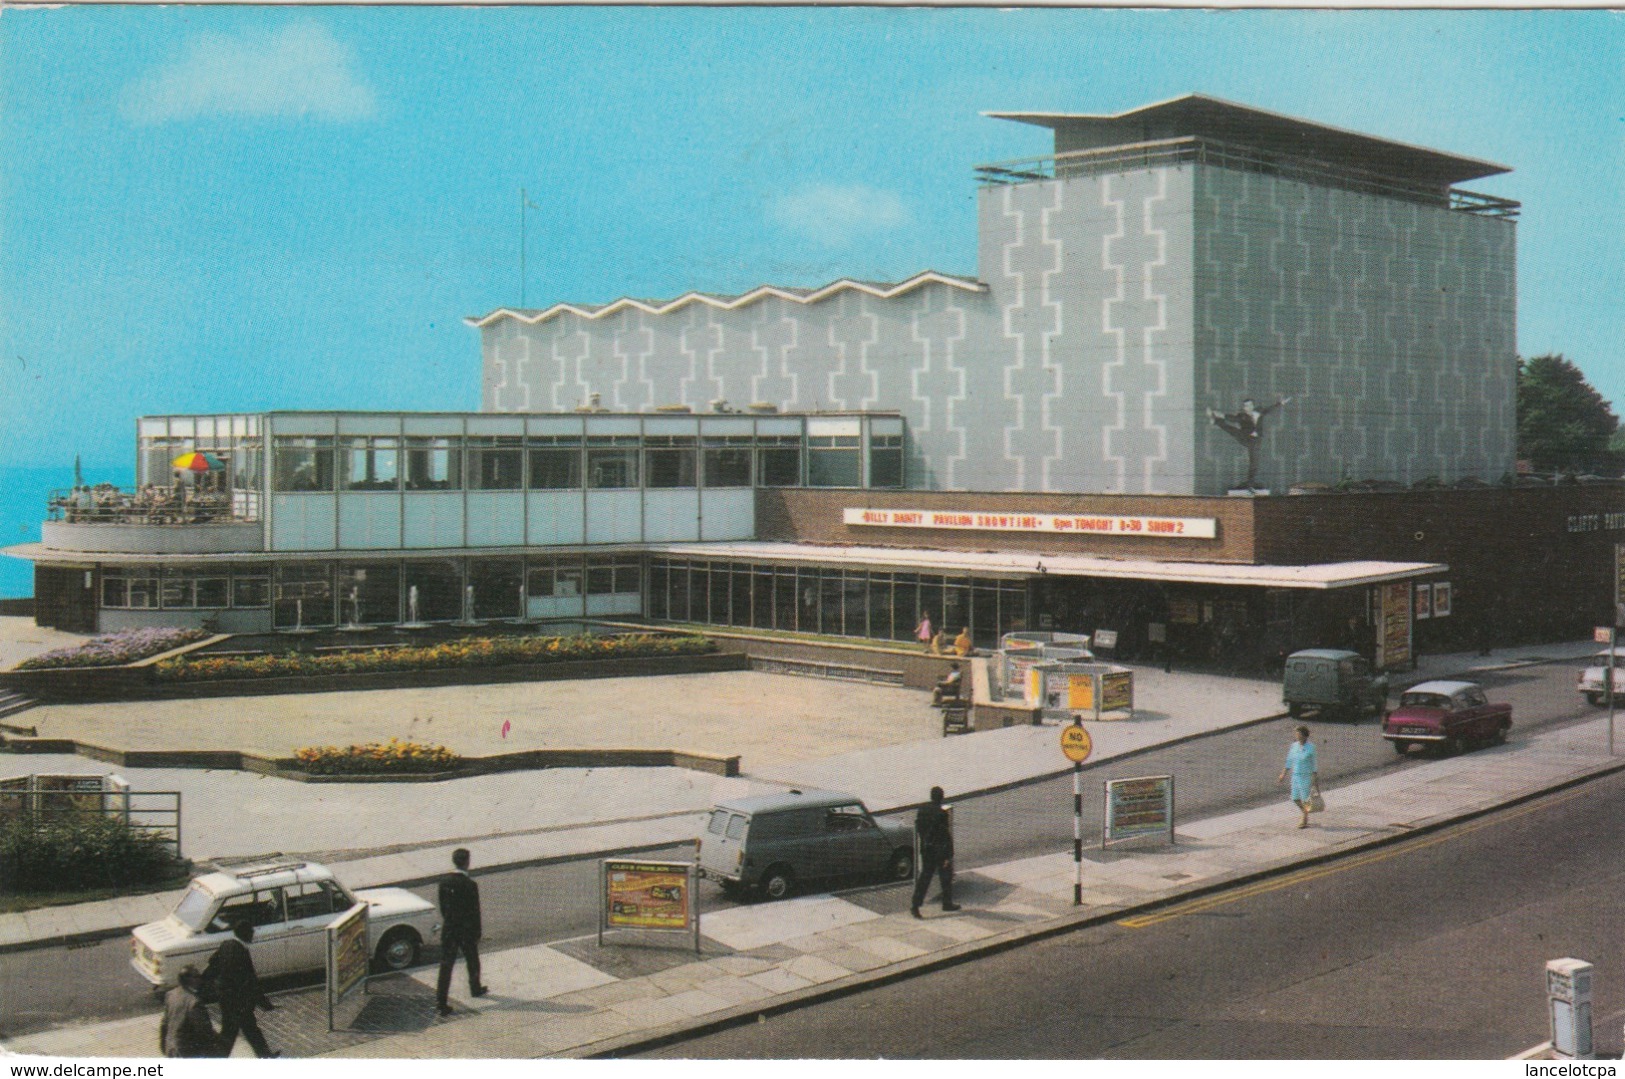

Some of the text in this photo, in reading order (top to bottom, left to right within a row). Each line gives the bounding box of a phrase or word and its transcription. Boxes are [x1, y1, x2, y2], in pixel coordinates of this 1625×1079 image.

[864, 511, 888, 523] BILLY
[933, 514, 973, 526] PAVILION
[1053, 517, 1072, 530] 6pm
[1074, 518, 1113, 531] TONIGHT
[1068, 732, 1083, 742] NO
